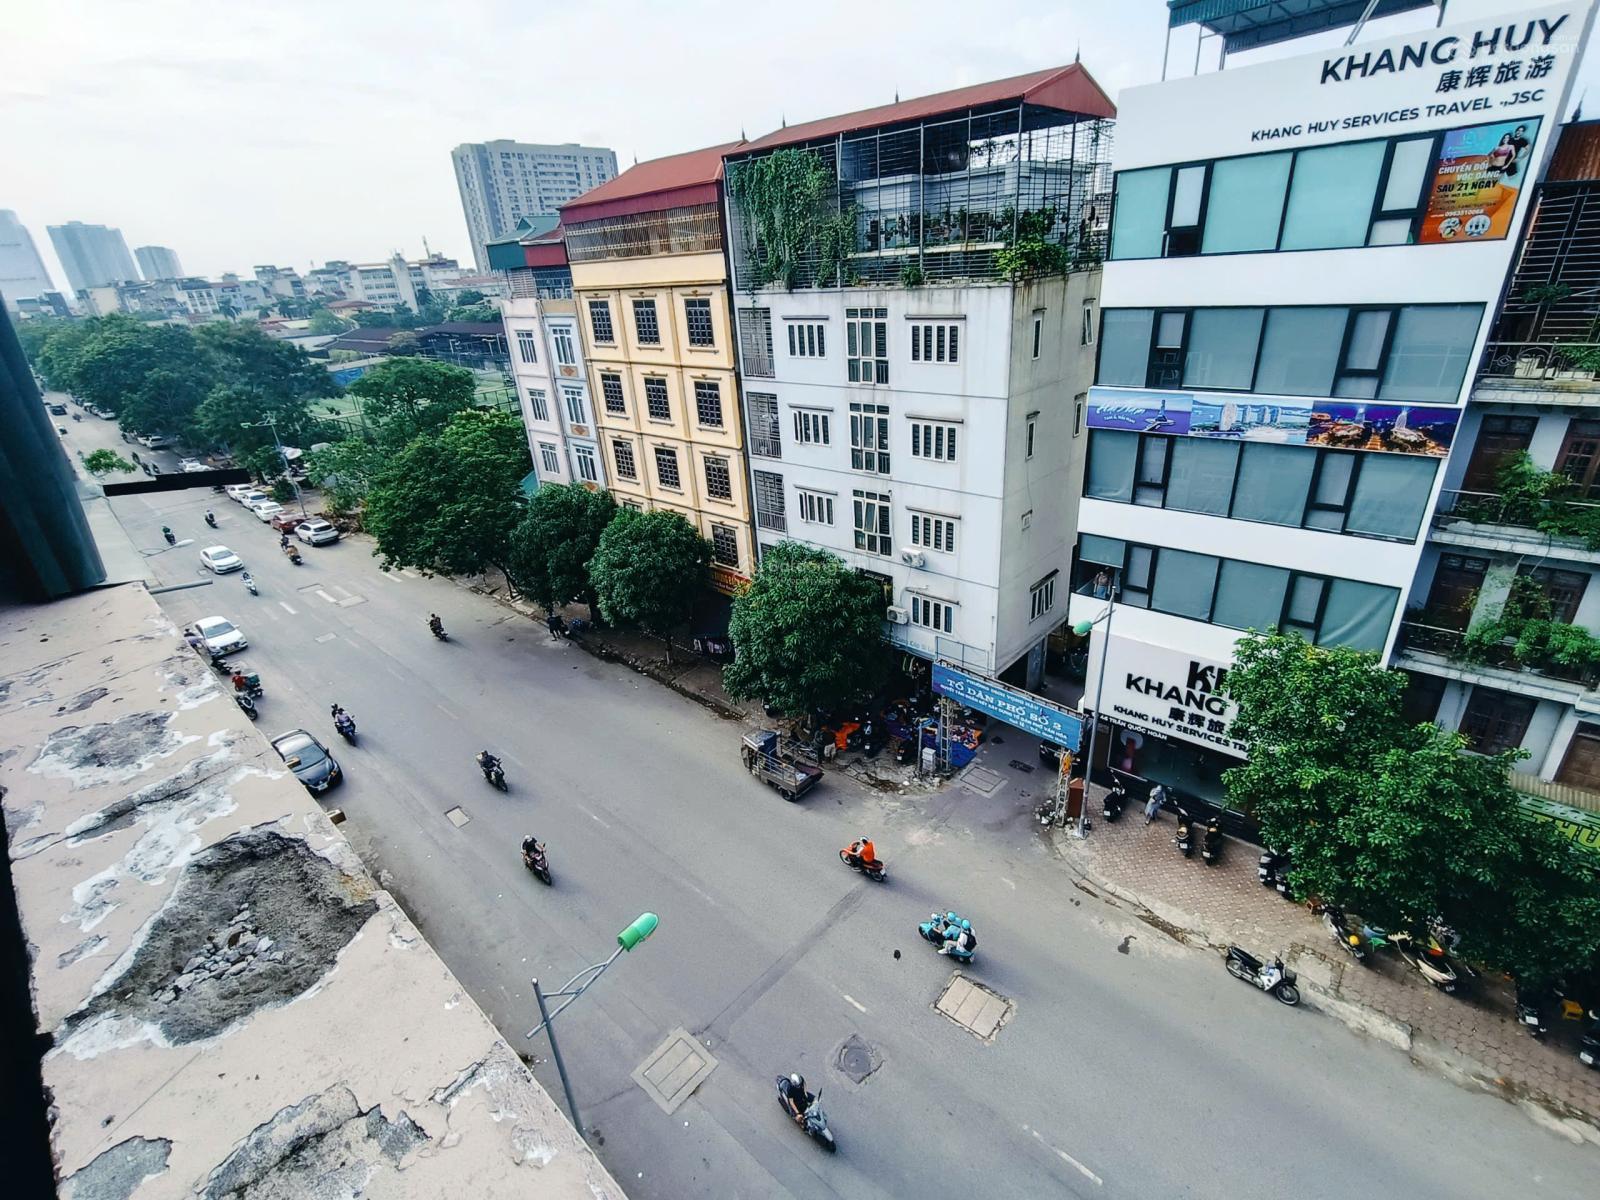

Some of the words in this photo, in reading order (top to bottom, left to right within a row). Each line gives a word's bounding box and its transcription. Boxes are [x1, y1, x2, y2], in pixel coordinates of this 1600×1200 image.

[1319, 36, 1460, 85] KHANG
[1468, 14, 1571, 59] HUY
[1434, 54, 1556, 94] 康辉旅游
[1250, 124, 1303, 142] KHANG
[1307, 119, 1339, 133] HUY
[1341, 108, 1419, 130] SERVICES
[1425, 97, 1493, 117] TRAVEL
[1436, 184, 1455, 193] SAU
[1456, 182, 1468, 192] 21
[966, 687, 994, 704] DÂN
[997, 699, 1026, 716] PHỐ
[1029, 711, 1050, 726] SỐ
[1125, 673, 1226, 716] KHANG
[1113, 704, 1149, 721] KHANG
[1151, 716, 1174, 729] HUY
[1175, 724, 1231, 747] SERVICES
[1127, 722, 1147, 734] QUỐC
[1168, 706, 1247, 740] 康辉旅
